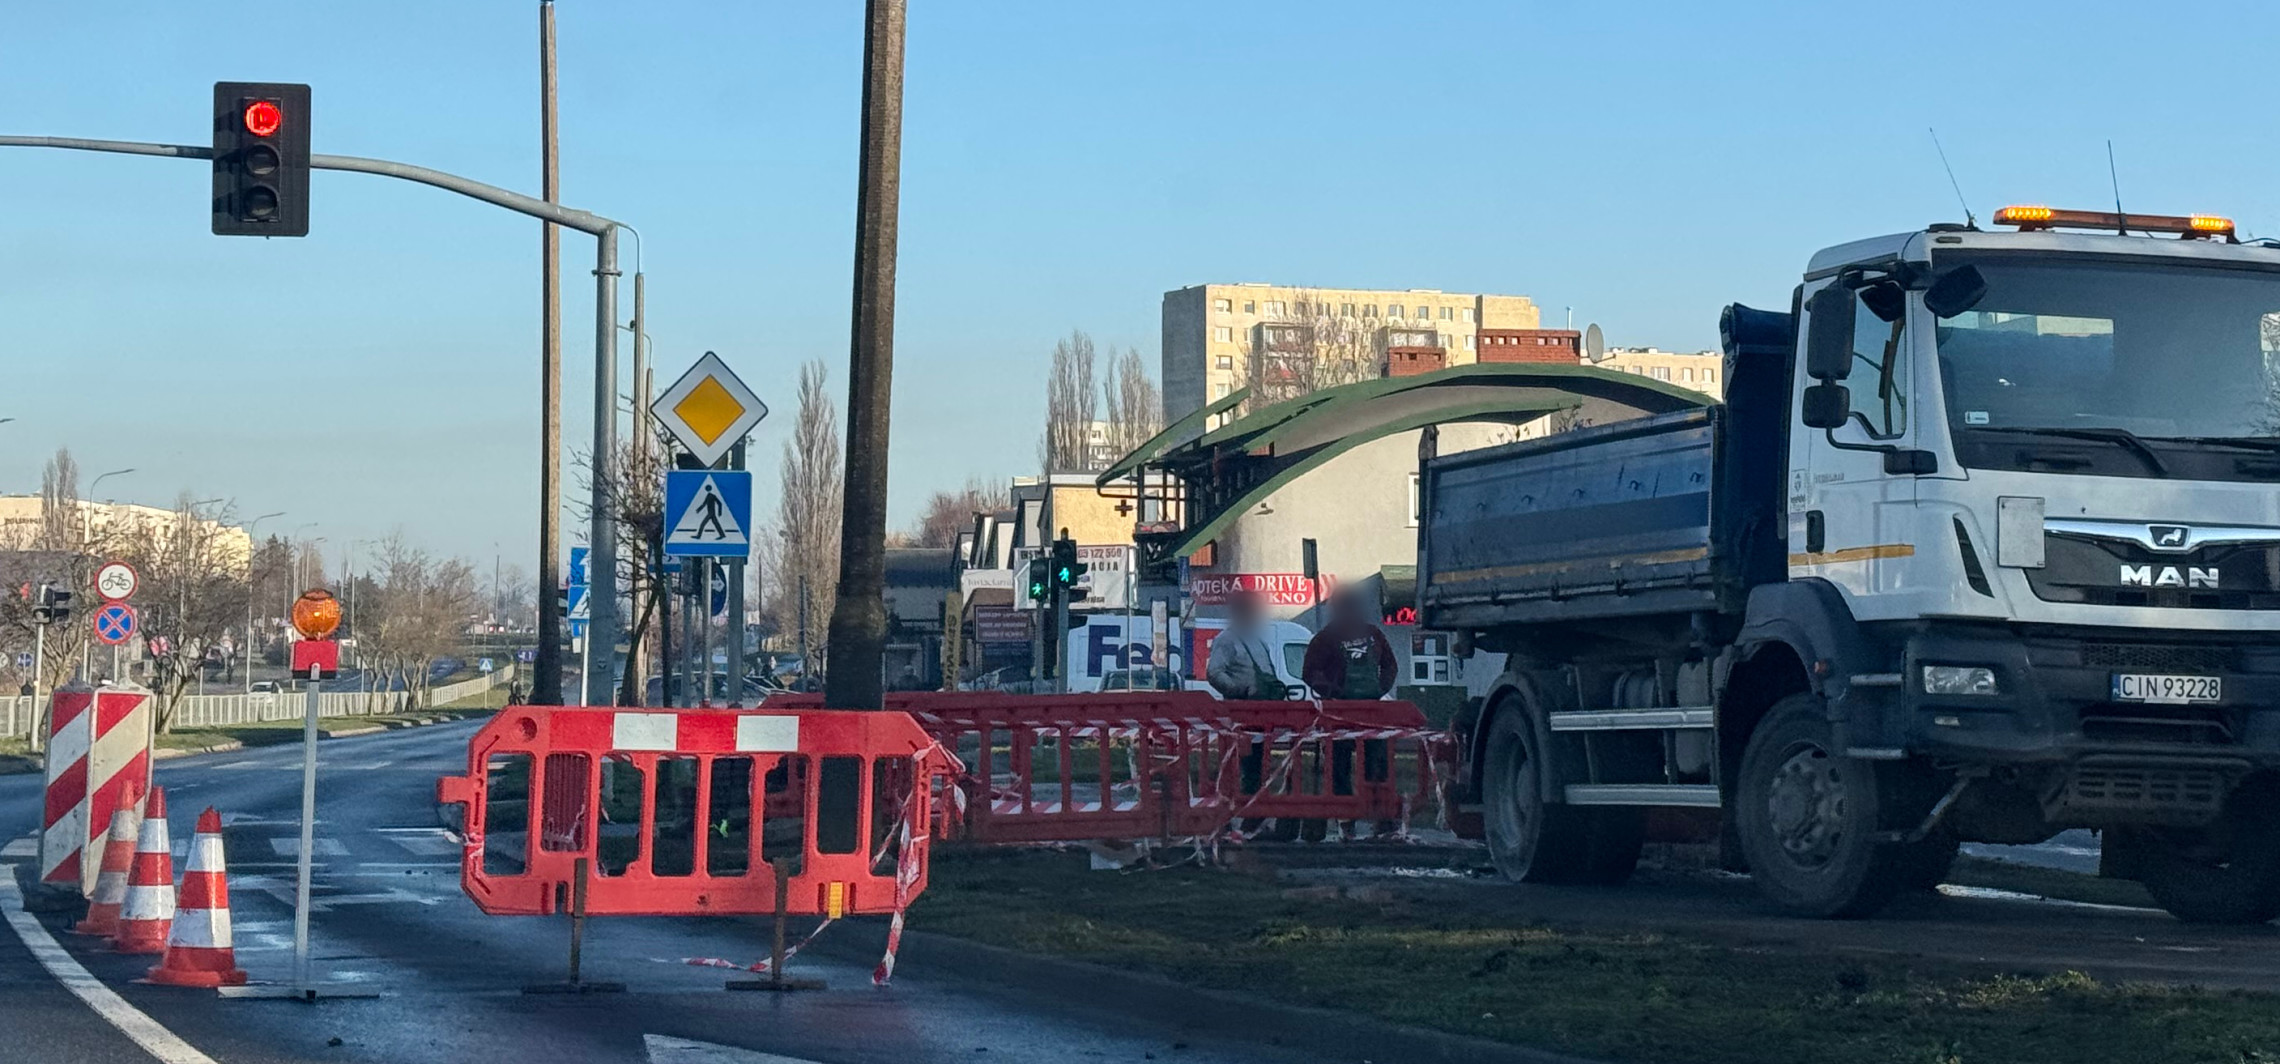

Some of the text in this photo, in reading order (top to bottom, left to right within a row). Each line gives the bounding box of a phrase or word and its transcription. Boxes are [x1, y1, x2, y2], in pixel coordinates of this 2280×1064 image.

[1254, 575, 1307, 592] DRIVE
[2120, 565, 2219, 588] MAN
[1268, 592, 1306, 604] KNO
[2122, 676, 2219, 699] CIN 93228
